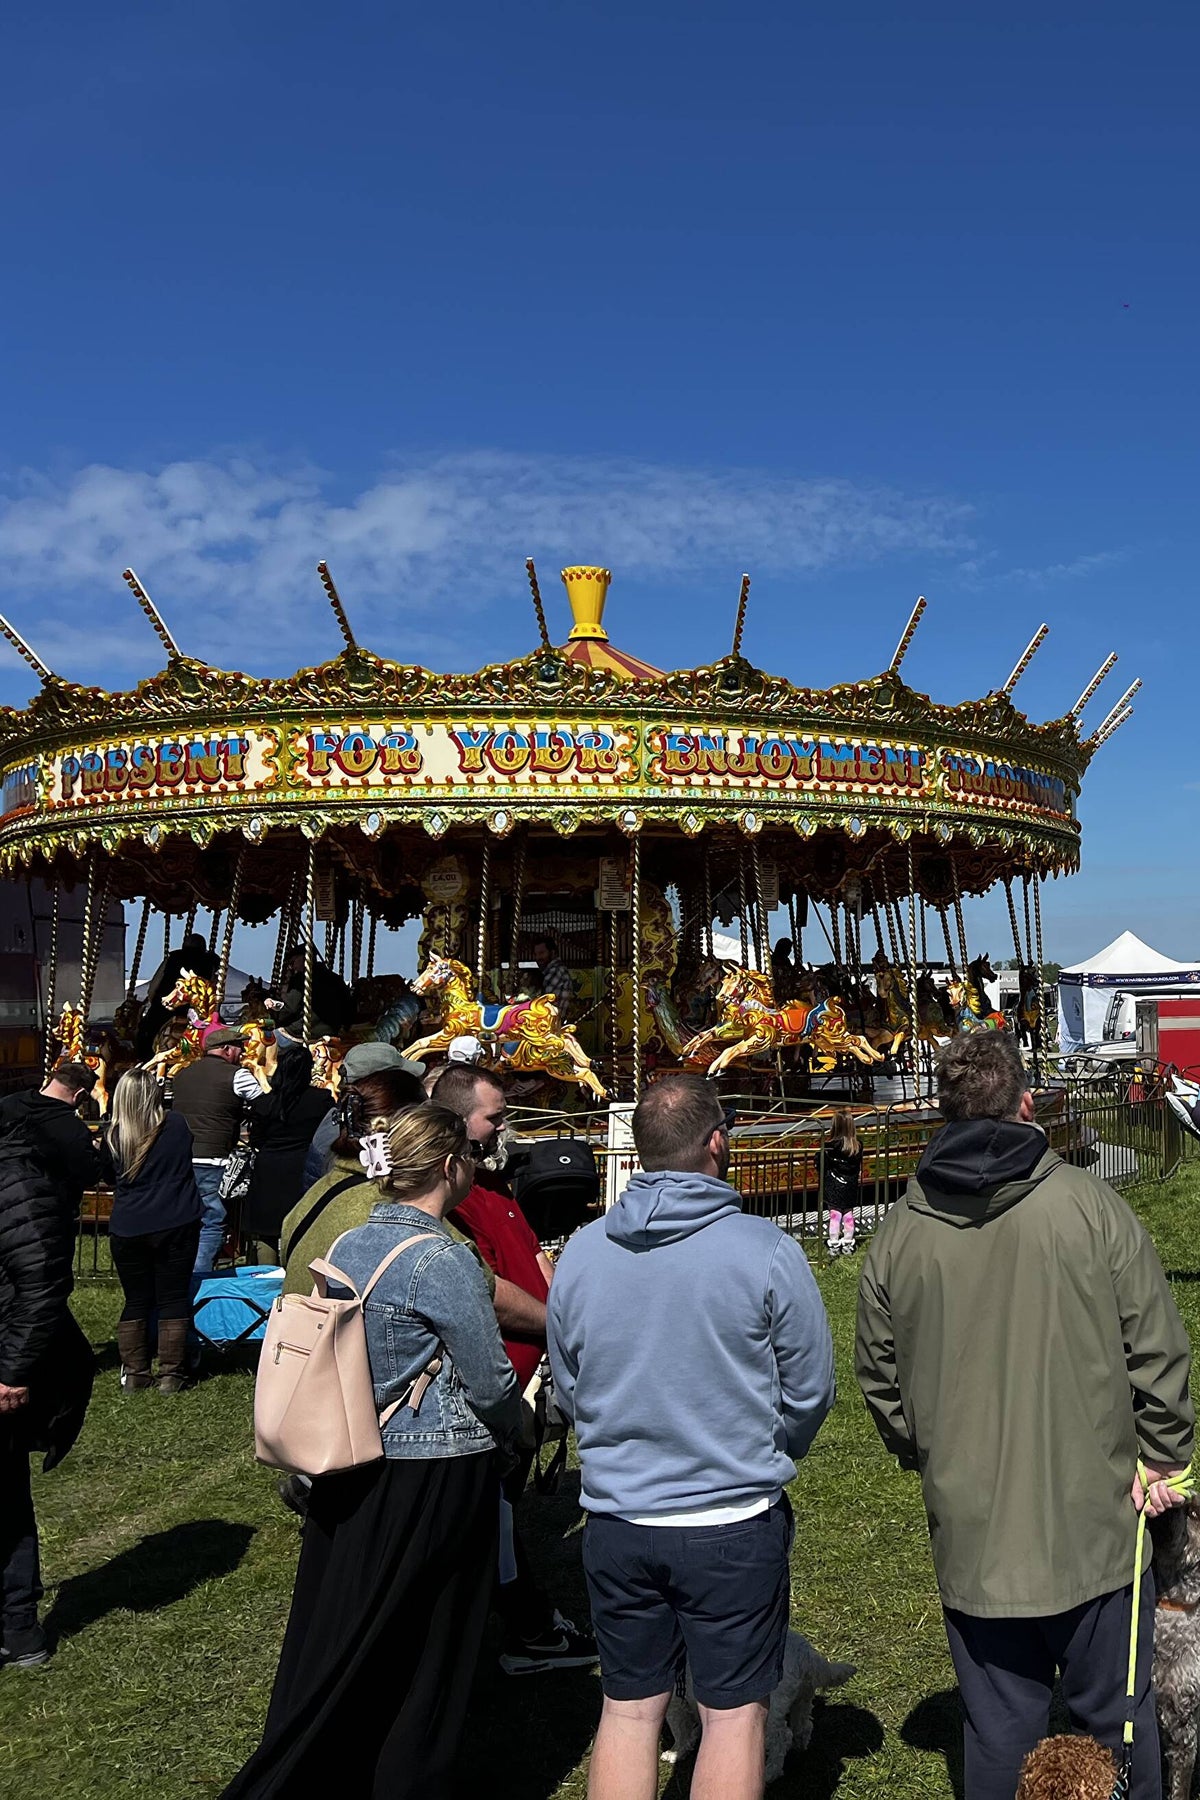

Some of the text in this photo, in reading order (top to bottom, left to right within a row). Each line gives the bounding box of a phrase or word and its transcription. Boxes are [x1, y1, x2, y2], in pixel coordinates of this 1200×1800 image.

[61, 737, 252, 800] PRESENT
[305, 731, 422, 777] FOR
[453, 730, 618, 777] YOUR
[661, 732, 929, 788] ENJOYMENT
